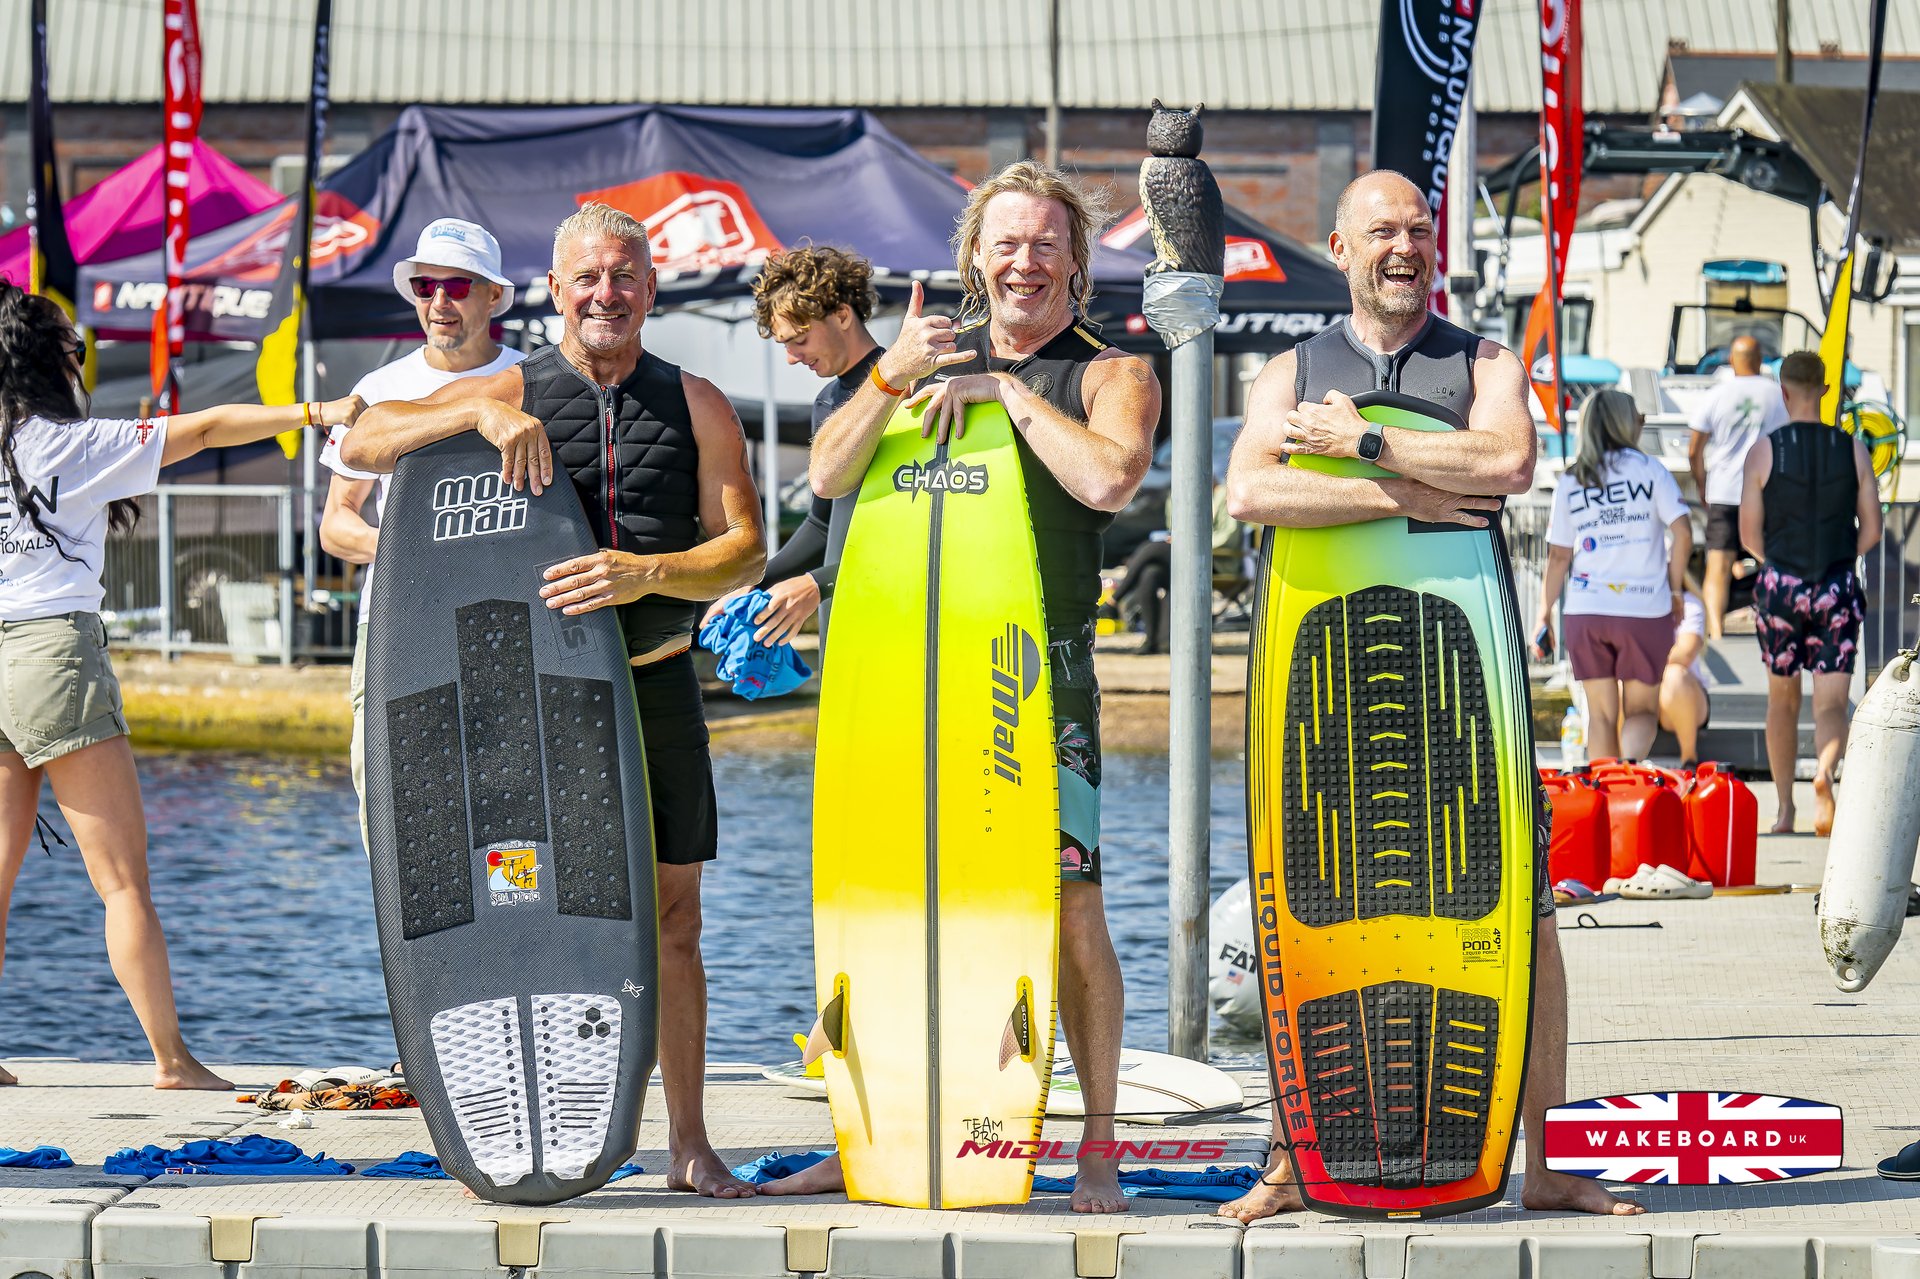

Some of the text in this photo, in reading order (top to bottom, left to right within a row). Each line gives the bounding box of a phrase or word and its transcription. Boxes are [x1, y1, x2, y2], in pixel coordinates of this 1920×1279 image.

[1422, 93, 1442, 162] 2025
[1427, 16, 1473, 211] NAUTIQUE
[116, 281, 273, 319] NATIQUE
[1214, 313, 1344, 337] UTIQU
[897, 468, 985, 490] CHAOS
[1568, 480, 1654, 514] CREW
[433, 497, 528, 541] maii
[983, 749, 993, 833] BOATS
[1219, 943, 1257, 974] FAT
[1462, 941, 1491, 951] POD
[1258, 872, 1308, 1132] LIQUID FORCE
[1020, 1004, 1028, 1047] CHAOS
[962, 1116, 1003, 1133] TEAM
[970, 1130, 999, 1143] PRO
